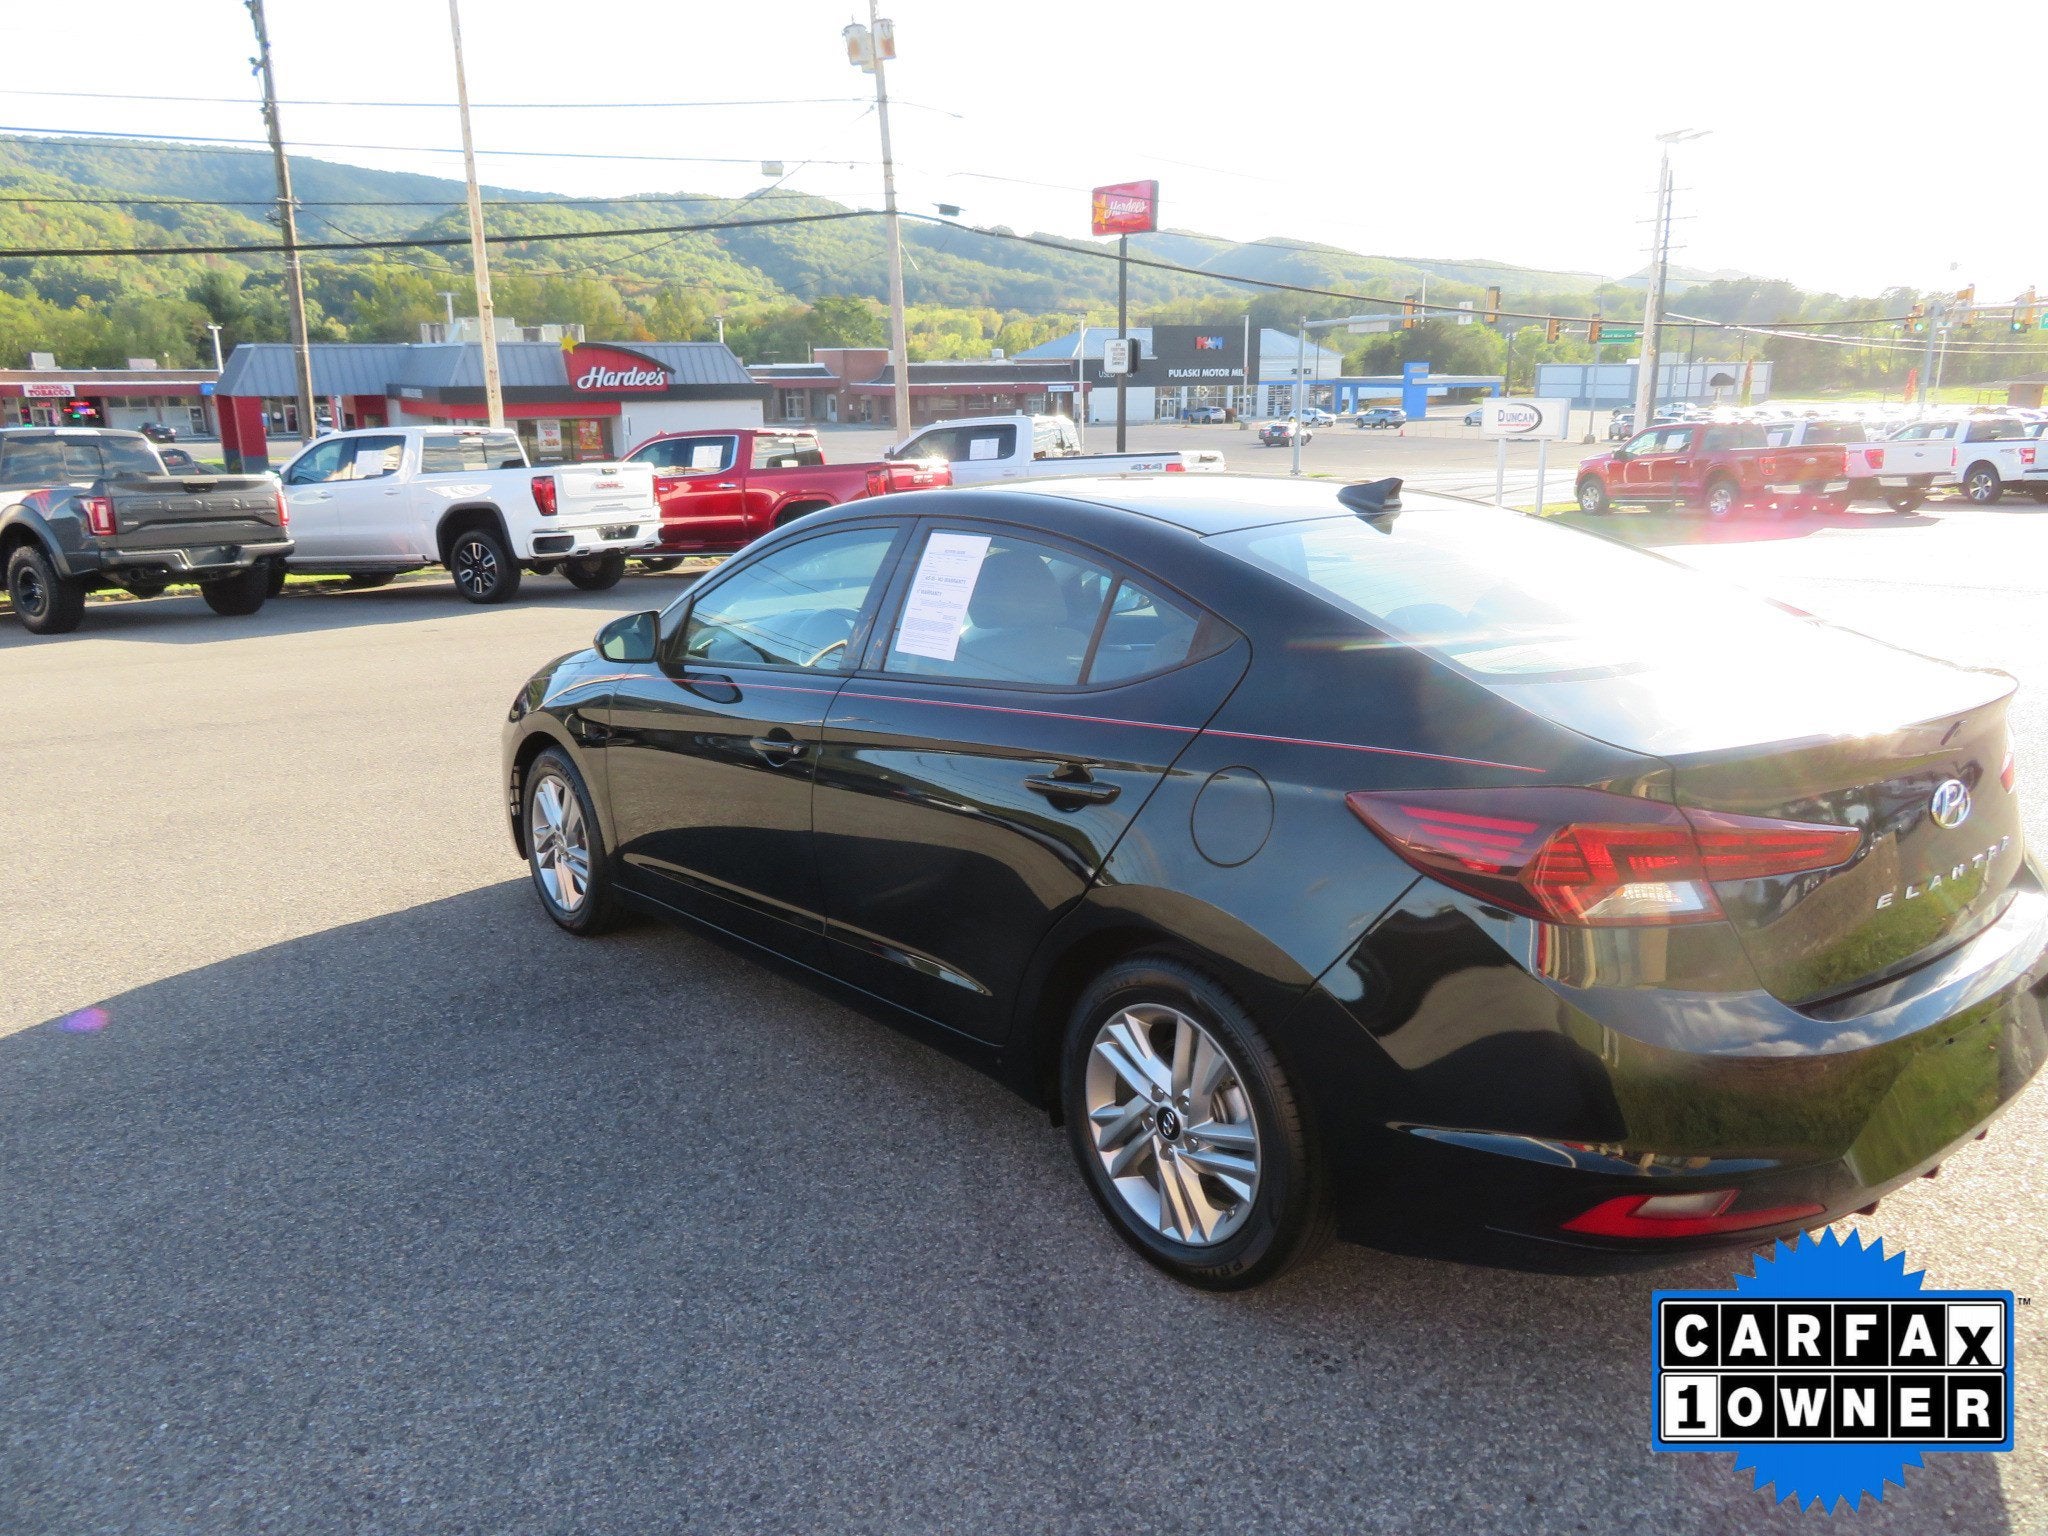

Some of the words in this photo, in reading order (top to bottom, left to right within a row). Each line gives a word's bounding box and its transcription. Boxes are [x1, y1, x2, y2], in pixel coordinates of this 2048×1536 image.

[577, 366, 665, 389] Hardee's
[1168, 368, 1200, 378] PULASKI
[1202, 368, 1230, 377] MOTOR
